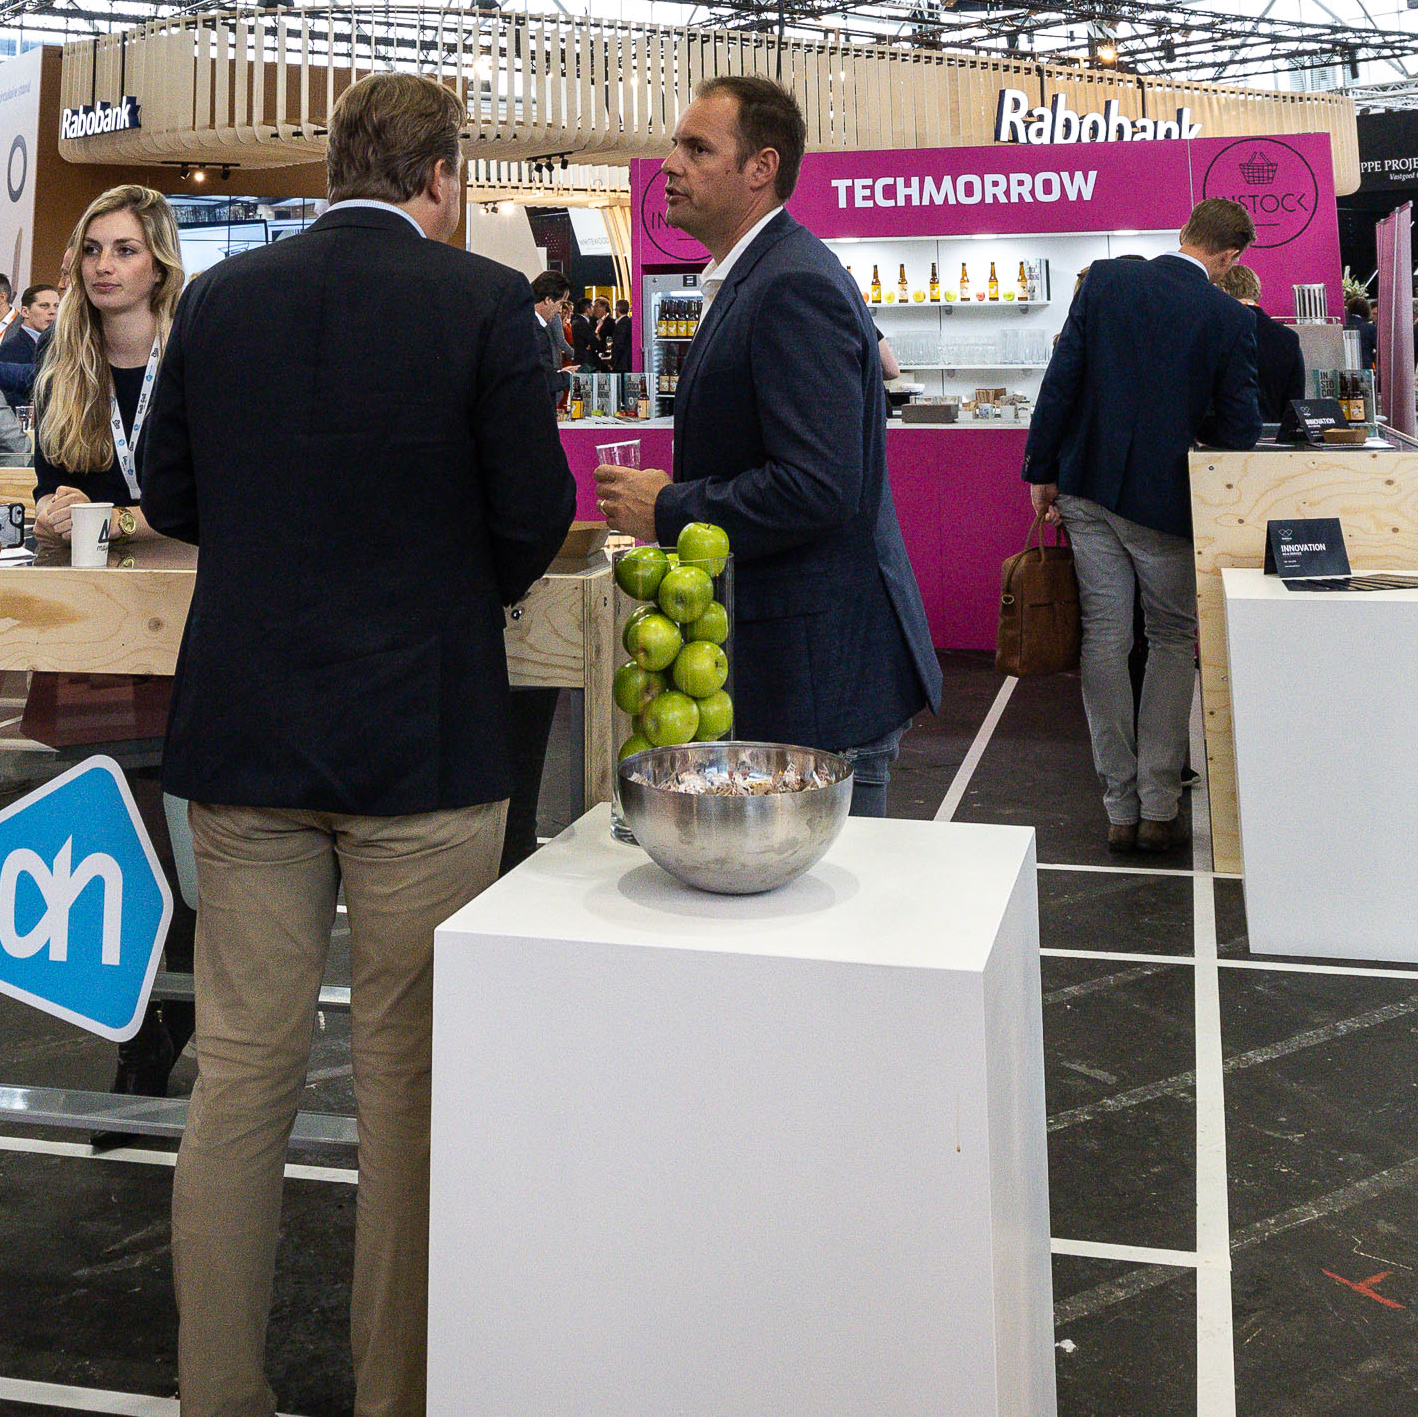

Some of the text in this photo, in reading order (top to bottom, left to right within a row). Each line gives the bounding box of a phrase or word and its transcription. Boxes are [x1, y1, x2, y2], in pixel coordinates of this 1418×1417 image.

[61, 95, 131, 139] Rabobank
[1360, 160, 1381, 173] PPE
[1389, 173, 1415, 182] Vastgoed
[831, 170, 1097, 209] TECHMORROW
[1280, 543, 1326, 552] INNOVATION
